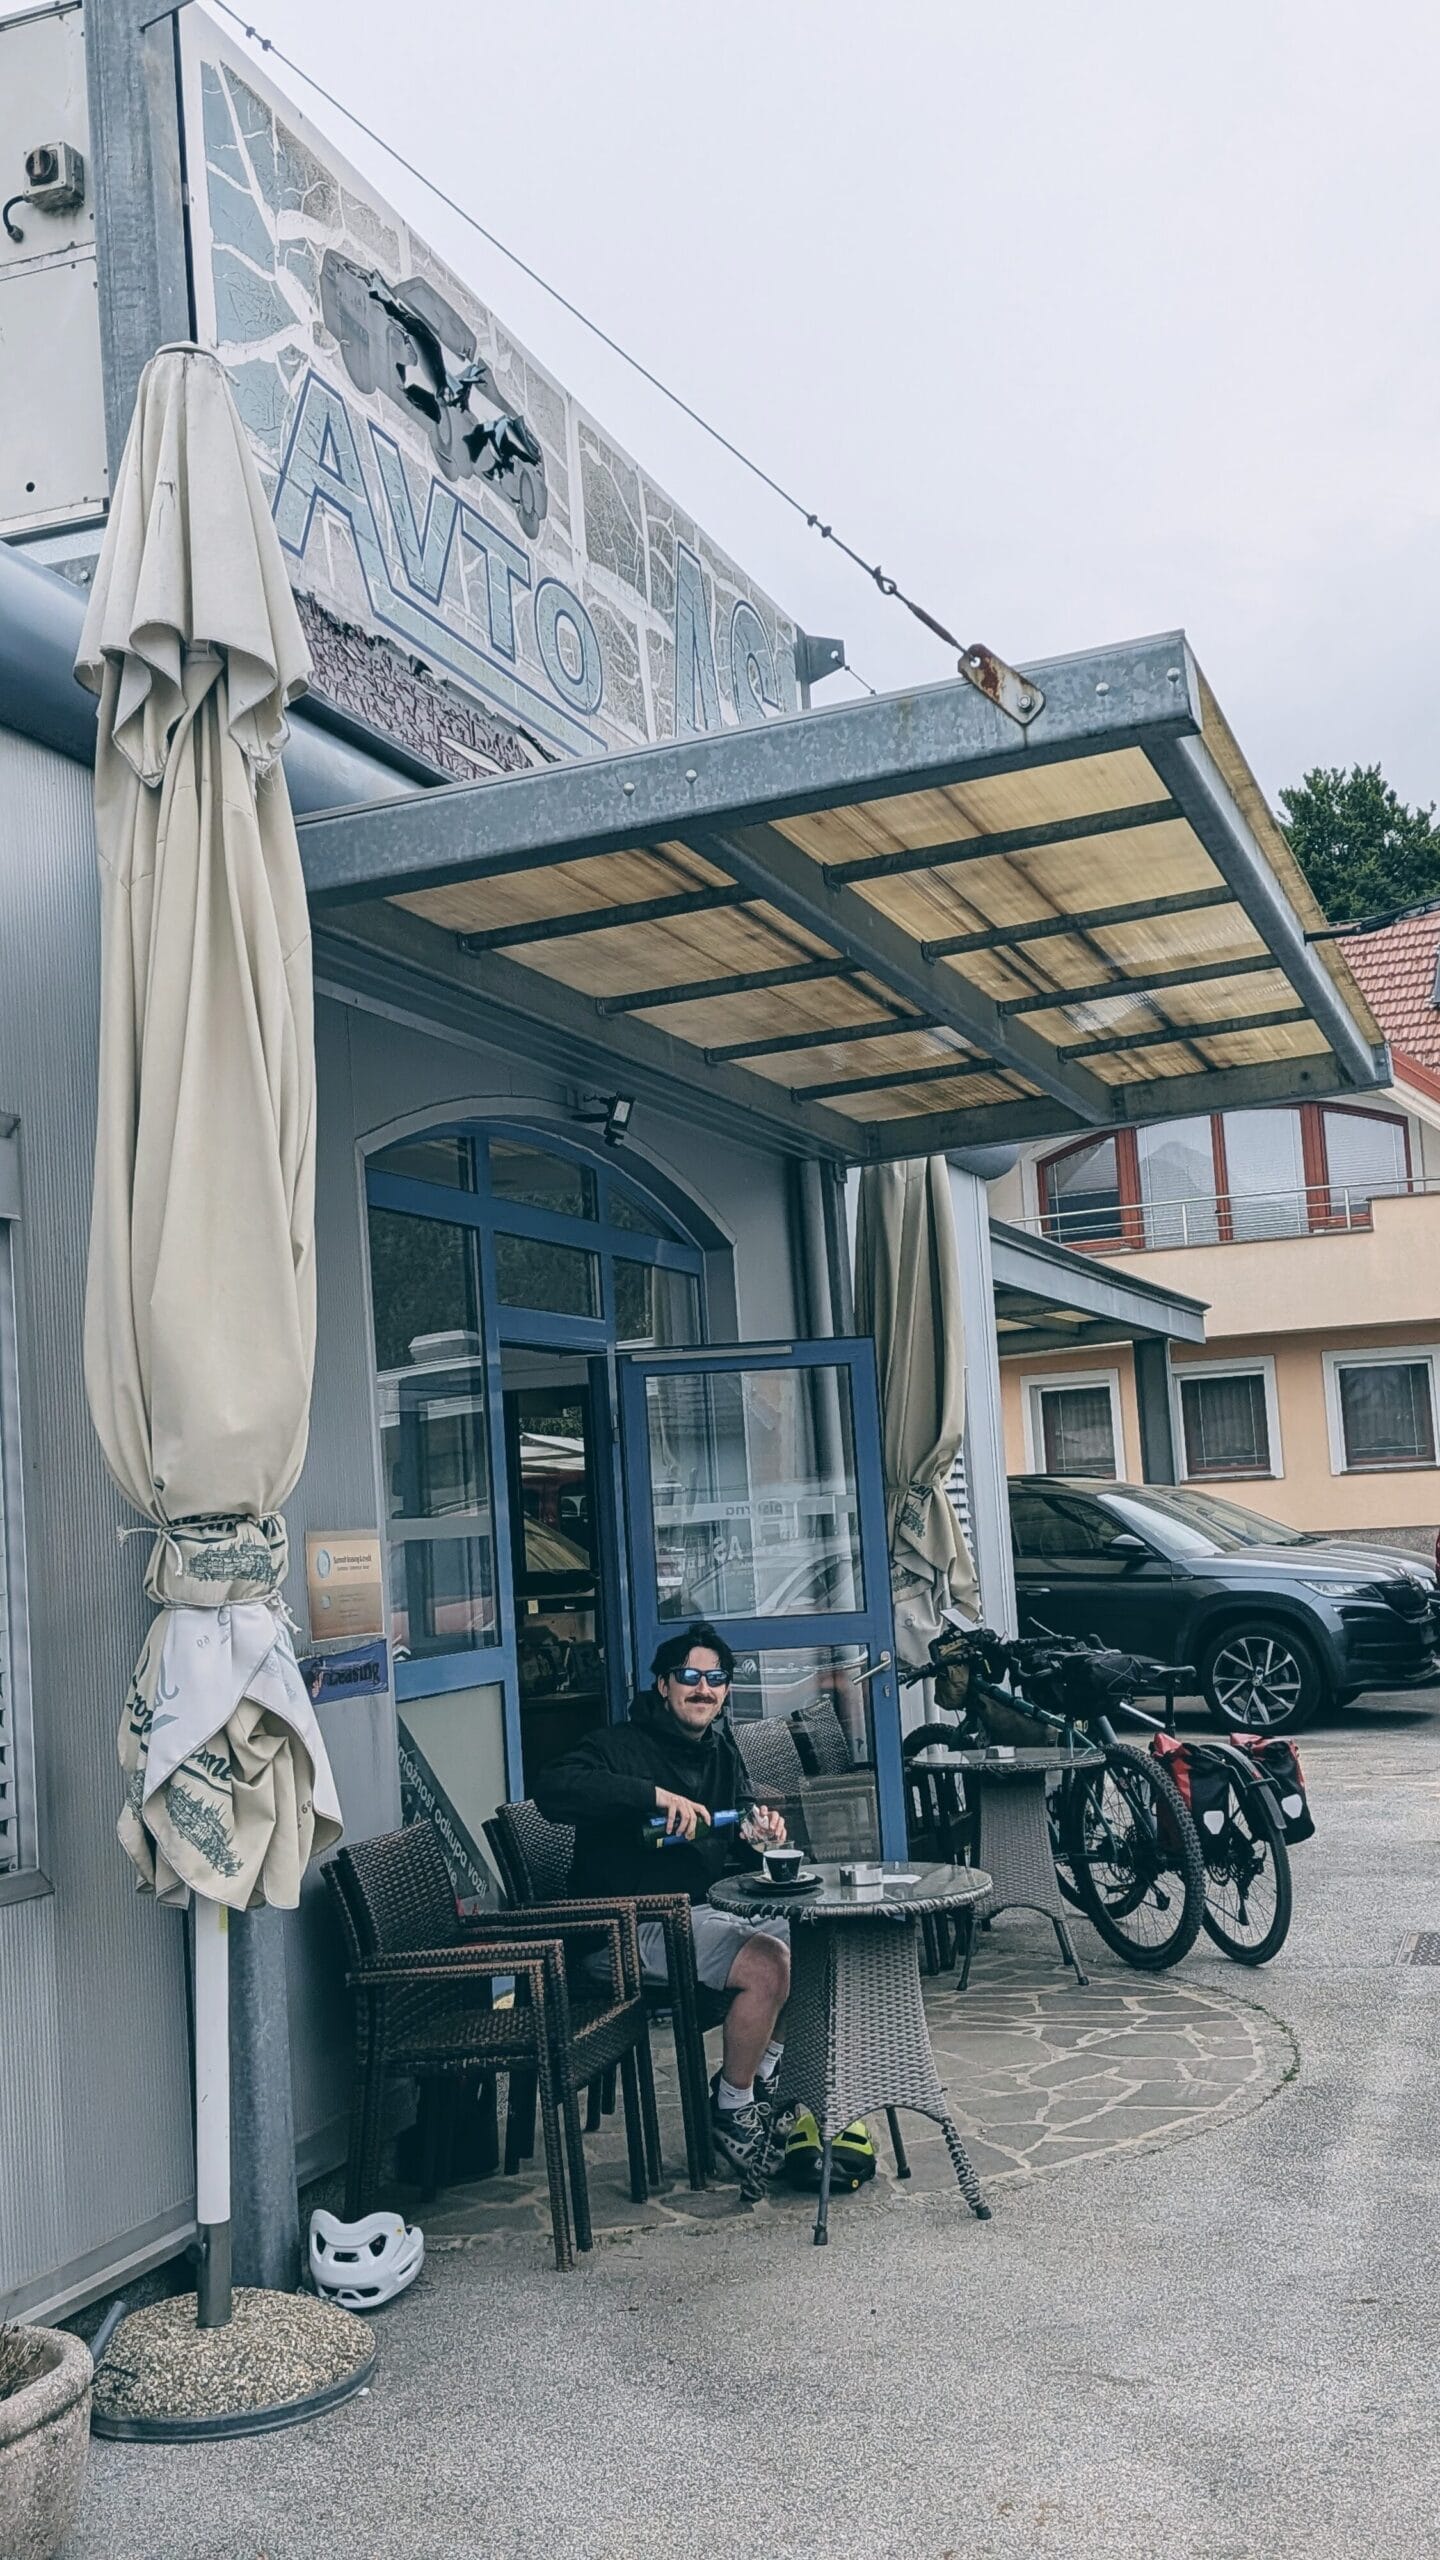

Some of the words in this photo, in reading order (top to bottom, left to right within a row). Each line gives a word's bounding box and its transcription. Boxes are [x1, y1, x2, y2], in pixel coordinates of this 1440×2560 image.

[275, 368, 605, 718] AVTO
[398, 1746, 436, 1812] možnost
[434, 1808, 468, 1869] odkupa
